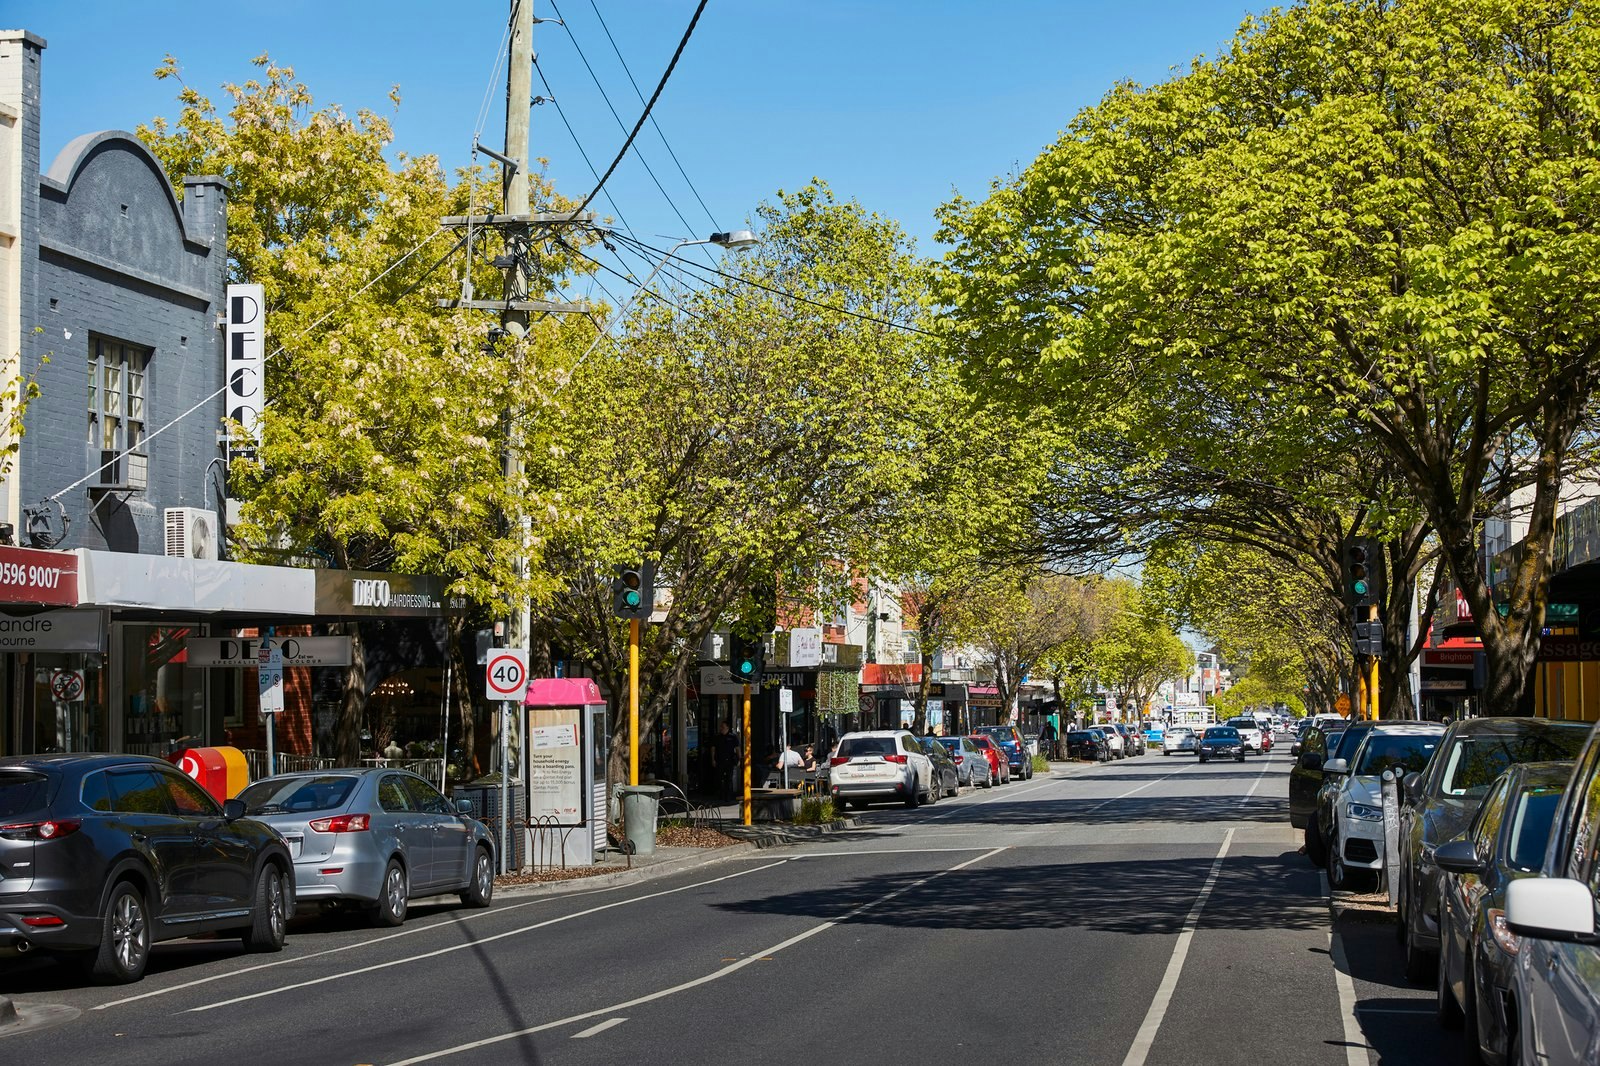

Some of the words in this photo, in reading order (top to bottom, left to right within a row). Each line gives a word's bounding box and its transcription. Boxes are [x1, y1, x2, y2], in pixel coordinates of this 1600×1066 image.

[230, 296, 259, 434] DECO
[29, 565, 60, 588] 9007
[352, 579, 390, 607] DECO
[389, 594, 431, 608] HAIRDRESSING
[0, 617, 52, 632] andre
[0, 636, 35, 646] ourne
[1440, 653, 1472, 662] Brighton
[1538, 641, 1600, 660] ssage
[260, 674, 270, 685] 2P
[493, 666, 519, 682] 40
